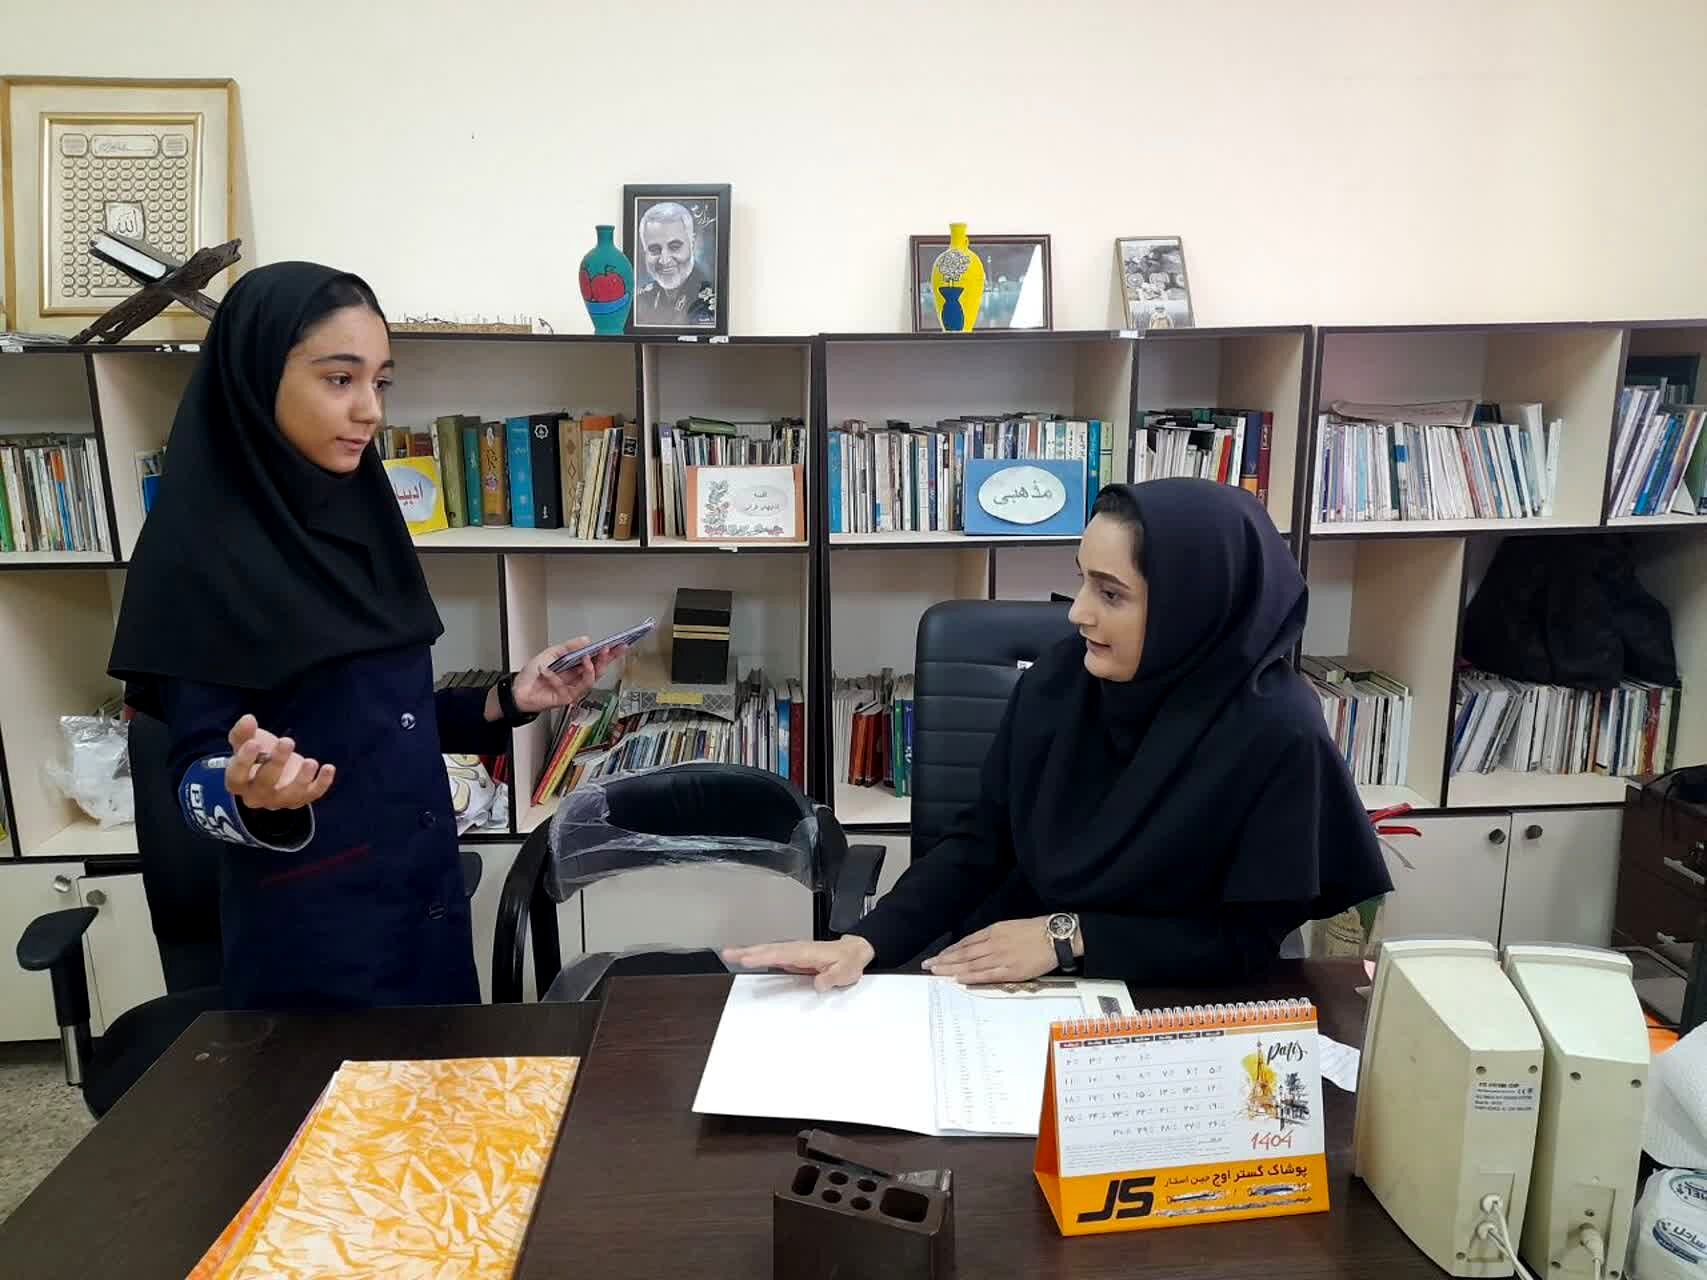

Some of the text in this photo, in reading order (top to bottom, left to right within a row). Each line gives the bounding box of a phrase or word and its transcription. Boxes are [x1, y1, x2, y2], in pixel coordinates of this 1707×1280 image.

[993, 480, 1053, 505] مذهبی
[1251, 1130, 1293, 1150] 1404
[1212, 1170, 1231, 1186] اوج
[1234, 1166, 1264, 1182] گستر
[1268, 1164, 1307, 1177] پوشاک
[1077, 1176, 1156, 1222] JS
